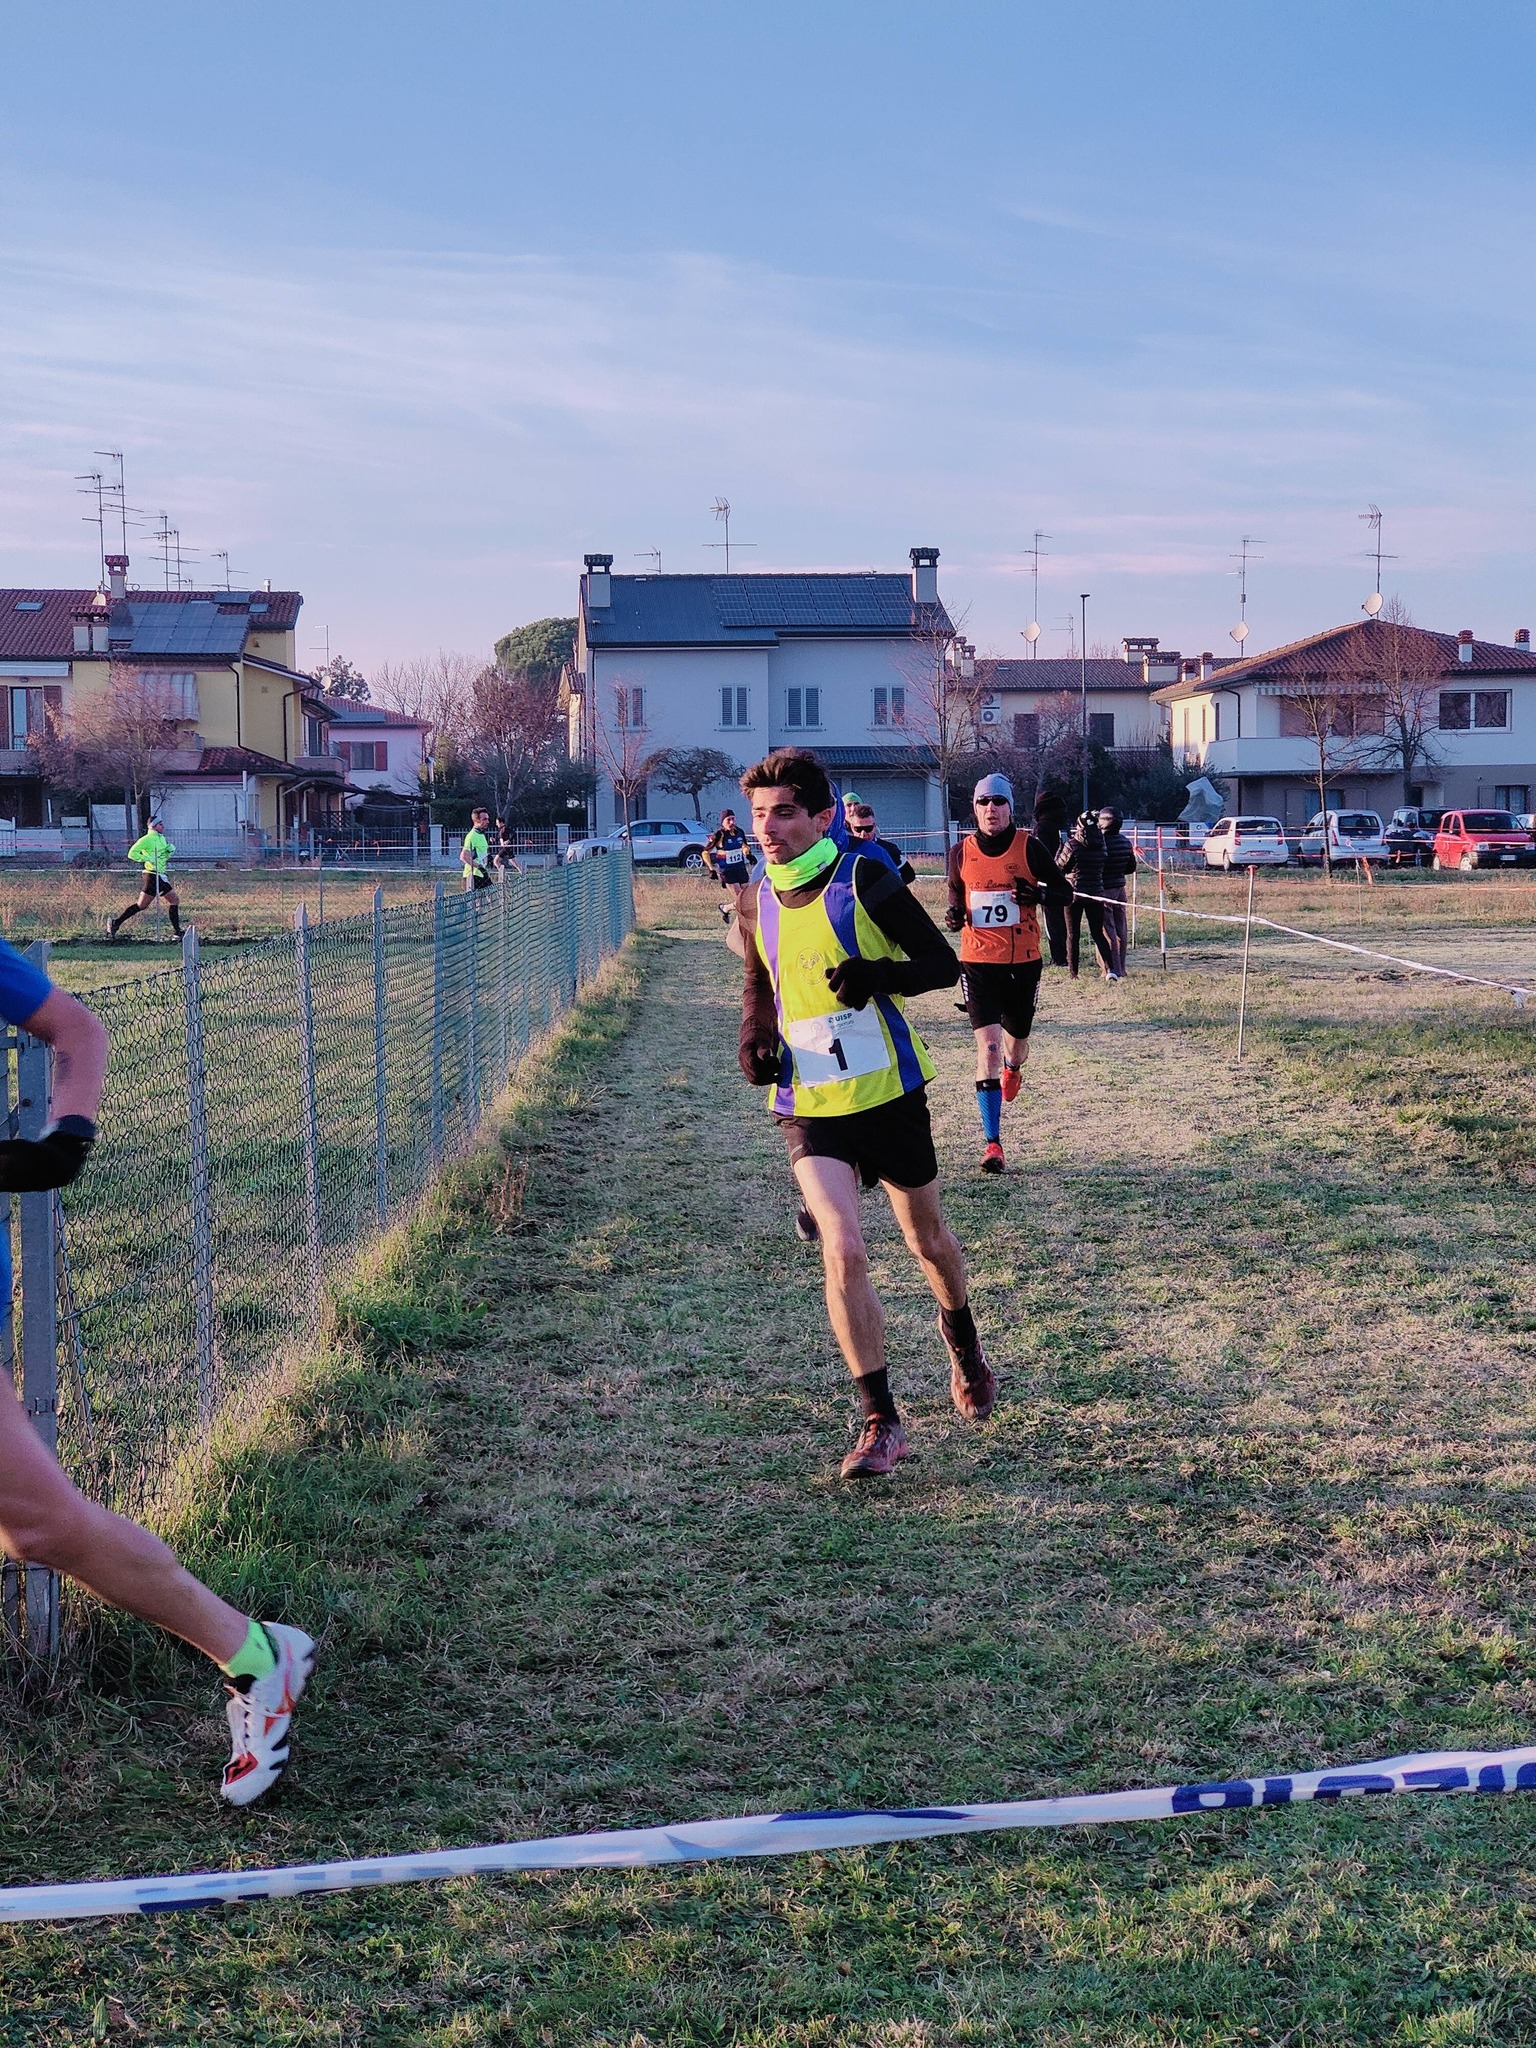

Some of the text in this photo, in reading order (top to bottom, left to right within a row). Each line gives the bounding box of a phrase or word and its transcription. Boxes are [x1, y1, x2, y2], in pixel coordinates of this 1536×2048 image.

[981, 904, 1008, 923] 79
[834, 1012, 853, 1022] UISP
[828, 1038, 848, 1071] 1
